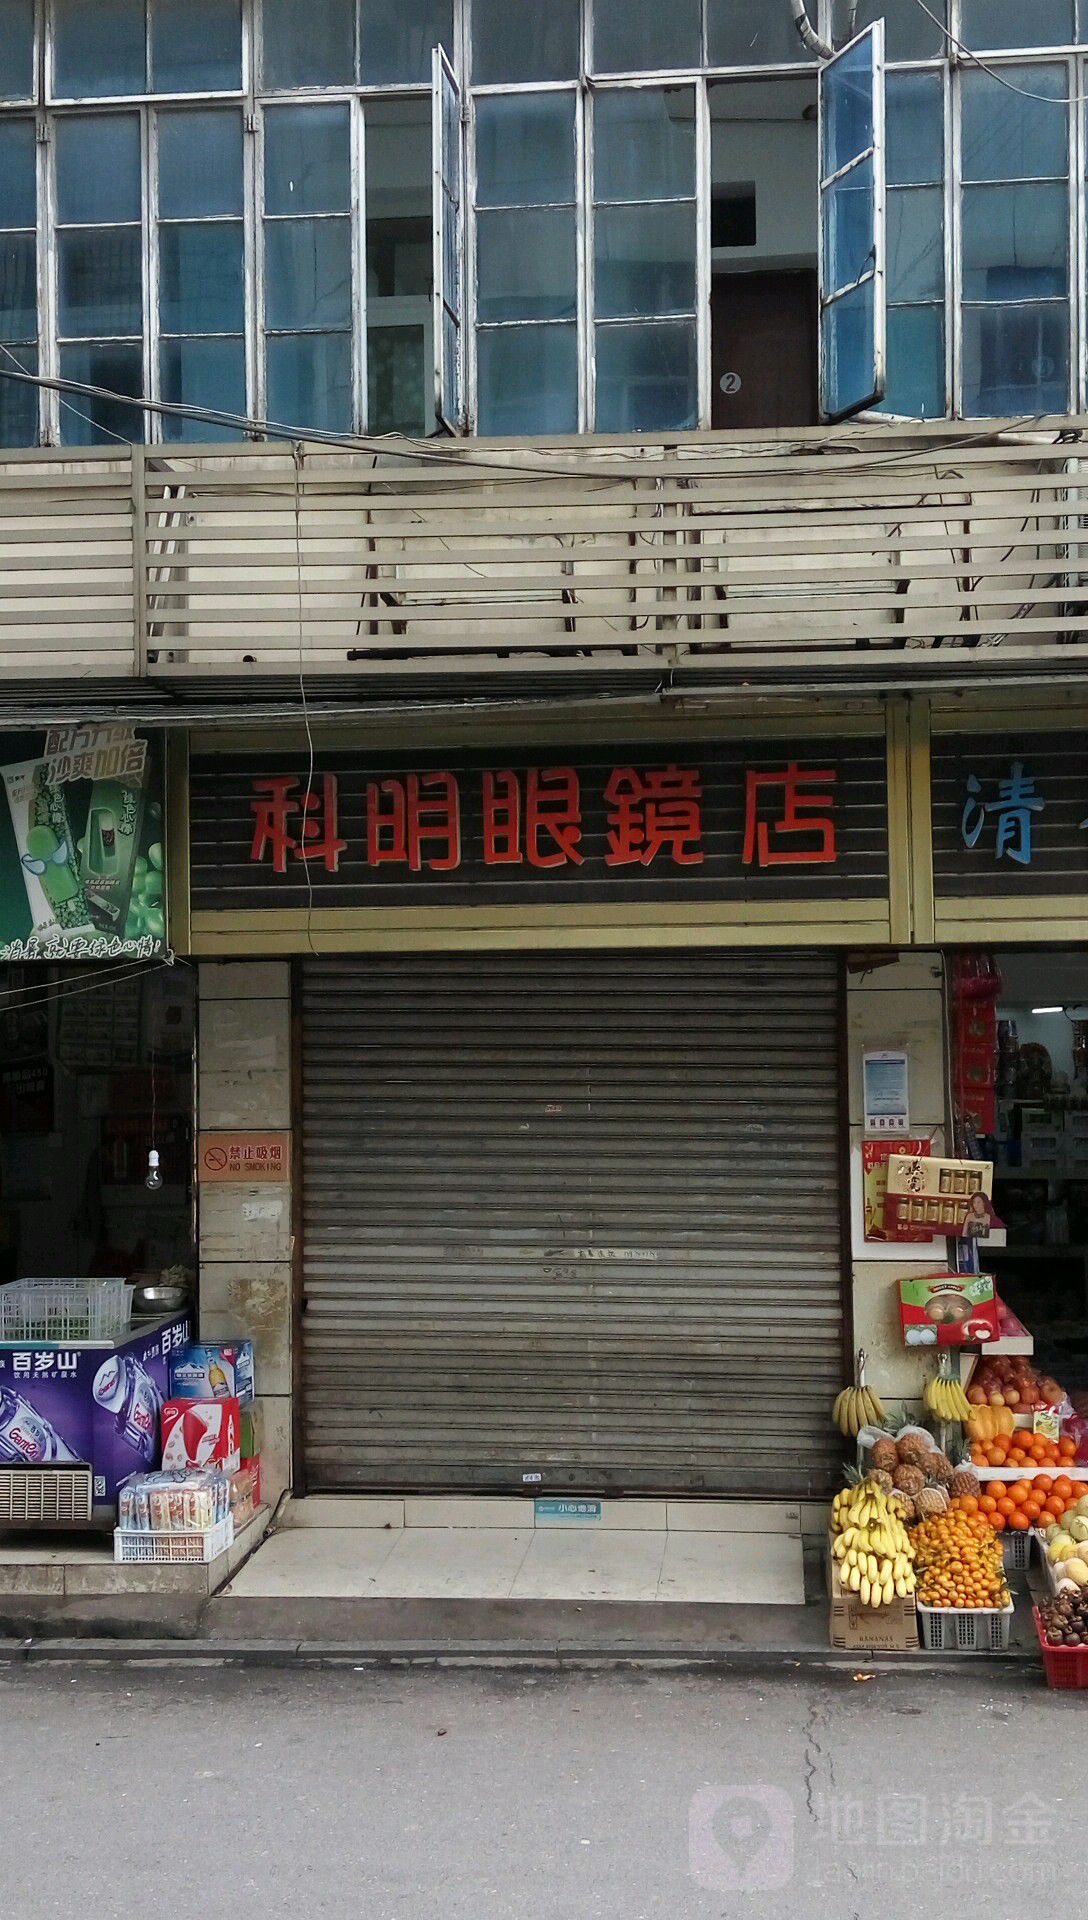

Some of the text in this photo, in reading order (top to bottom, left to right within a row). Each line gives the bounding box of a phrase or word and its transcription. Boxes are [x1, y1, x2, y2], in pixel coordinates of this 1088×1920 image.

[726, 374, 735, 391] 2
[250, 762, 838, 873] 科明眼鏡店
[229, 1145, 283, 1160] 禁止吸烟
[229, 1162, 282, 1171] NO SMOKING
[161, 1319, 191, 1355] 百岁山
[12, 1351, 78, 1371] 百岁山
